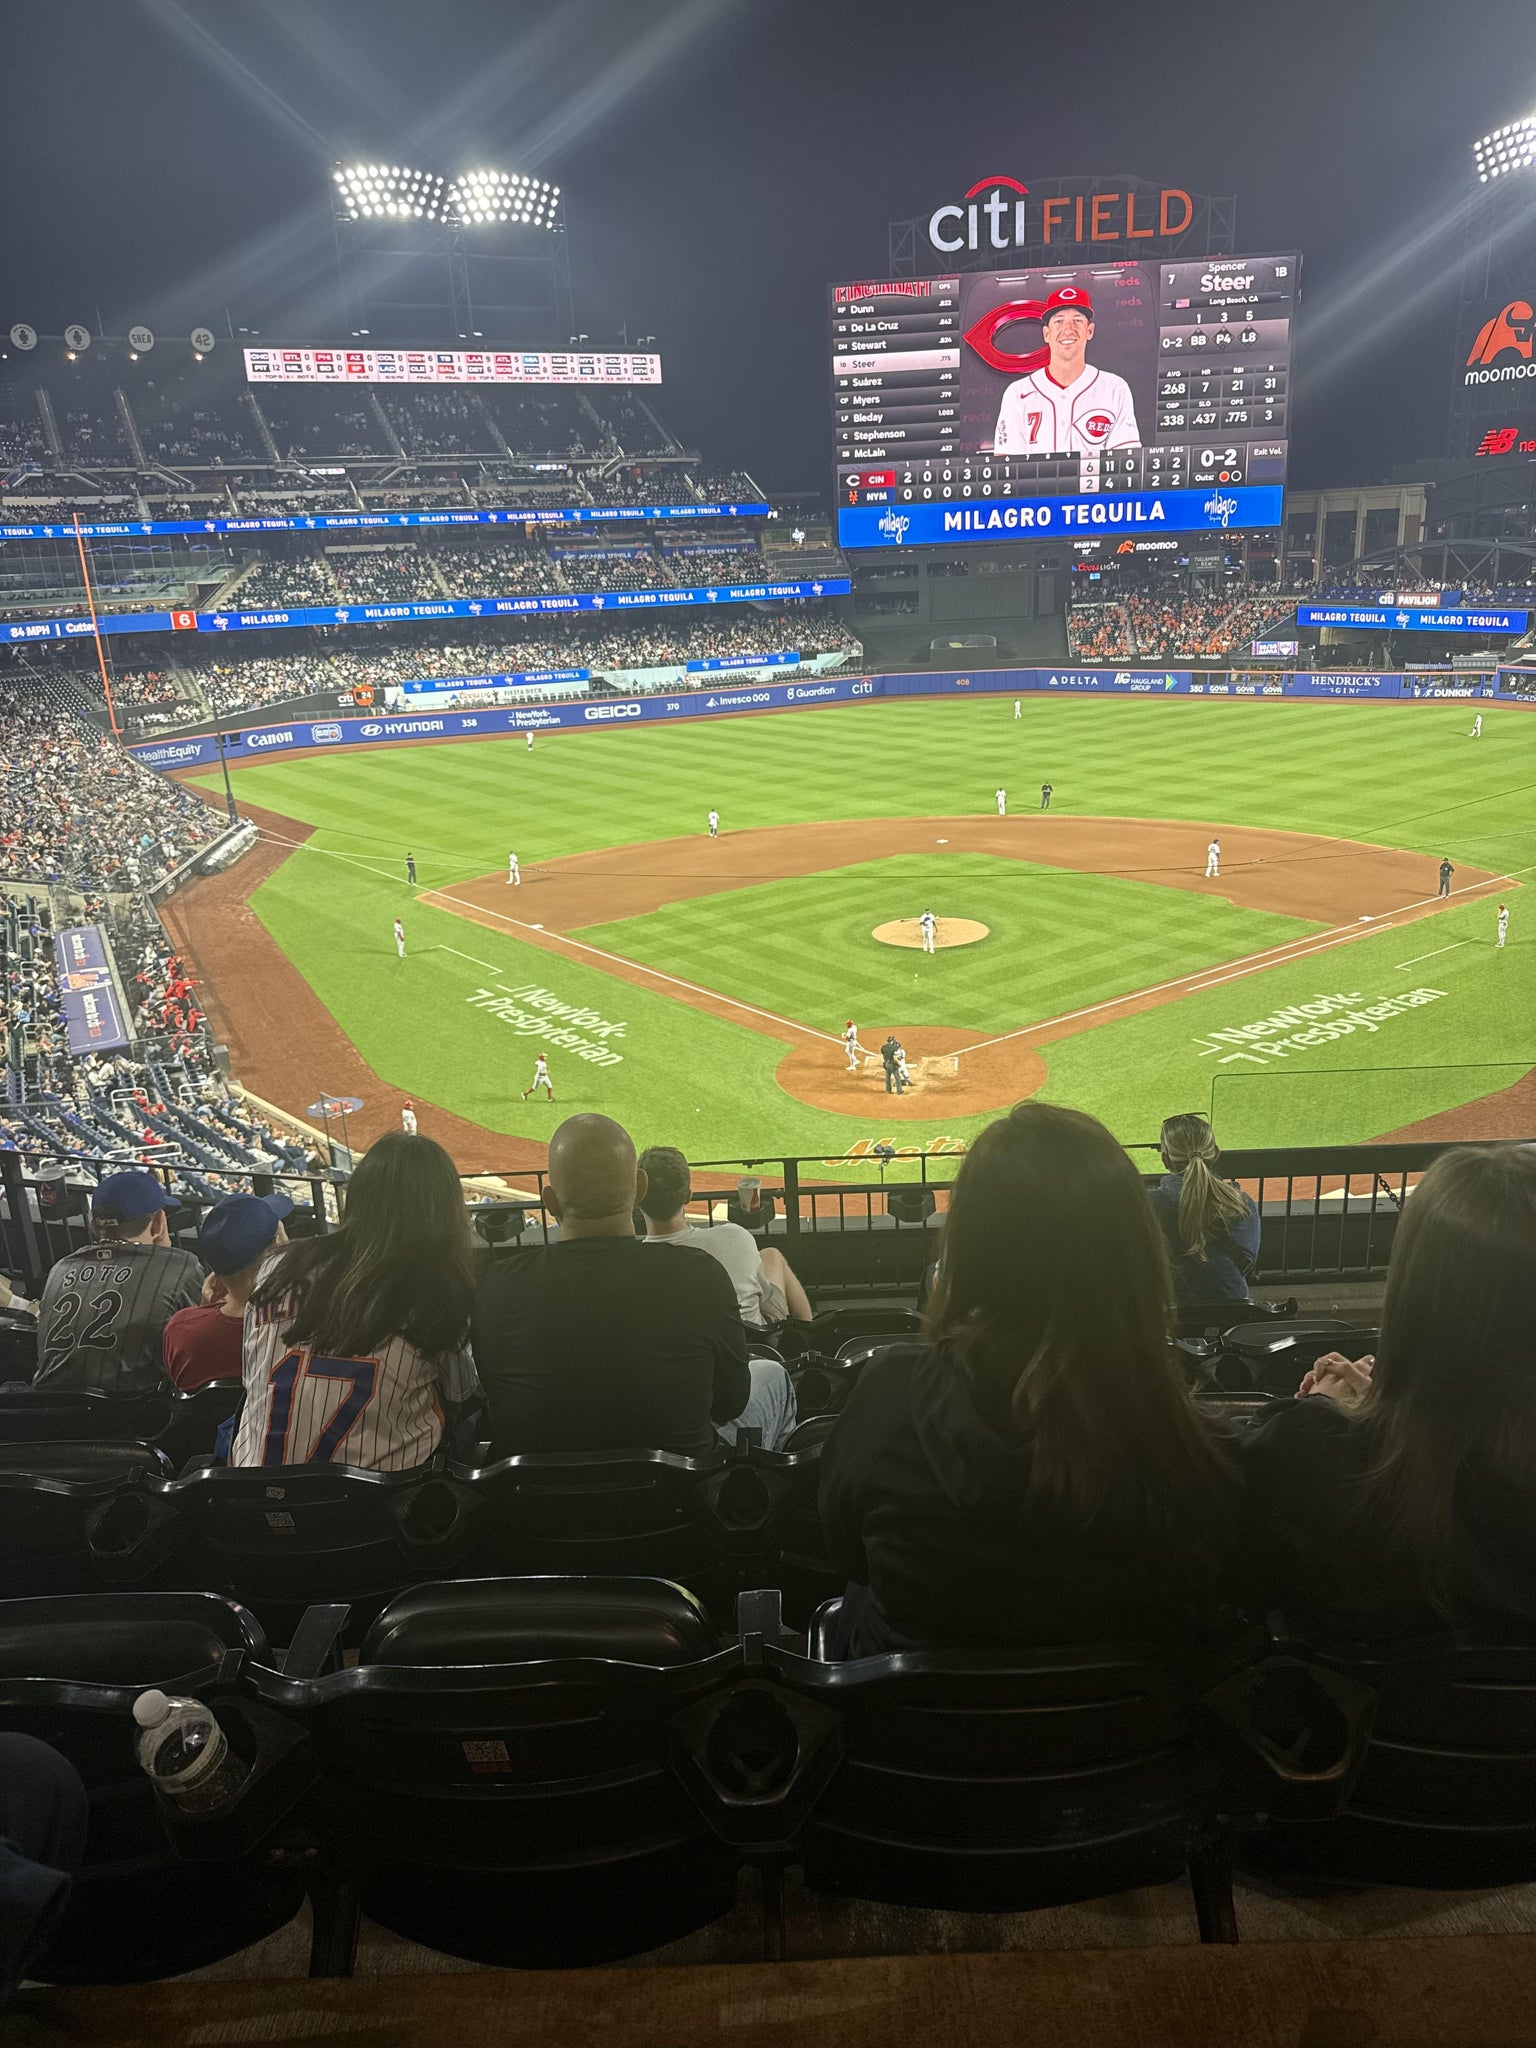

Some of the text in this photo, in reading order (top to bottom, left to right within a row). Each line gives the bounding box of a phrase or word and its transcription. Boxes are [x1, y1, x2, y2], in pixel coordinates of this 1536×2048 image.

[929, 187, 1193, 252] citi FIELD
[1209, 262, 1246, 273] Spencer
[1168, 266, 1287, 293] 7 Steer 1B
[835, 281, 931, 302] CINCINNATI
[1209, 295, 1258, 306] Long Beach, CA
[850, 304, 874, 315] Dunn
[1196, 311, 1253, 323] 1 3 5
[851, 321, 899, 332] De La Cruz
[132, 334, 152, 344] SHEA
[195, 334, 211, 346] 42
[1162, 331, 1256, 348] 0-2 BB P4 L8
[851, 340, 887, 351] Stewart
[272, 364, 280, 372] 12
[852, 359, 876, 369] Steer
[1201, 368, 1211, 376] HR
[1233, 366, 1244, 374] RBI
[1464, 363, 1536, 386] moomoo
[852, 376, 882, 388] Suárez
[1161, 377, 1276, 395] .268 7 21 31
[853, 395, 880, 407] Myers
[1198, 400, 1211, 408] SLG
[1230, 398, 1244, 406] OPS
[853, 412, 883, 424] Bleday
[1160, 410, 1272, 426] .338 .437 .775 3
[854, 428, 905, 443] Stephenson
[854, 448, 885, 459] McLain
[1253, 447, 1283, 456] Exit Vel.
[1200, 449, 1237, 467] 0-2
[868, 458, 1181, 484] CIN 2 0 0 3 0 1 6 11 0 3 2
[1195, 473, 1215, 482] Outs:
[866, 475, 1180, 501] NYM 0 0 0 0 0 2 2 4 1 2 2
[1204, 488, 1238, 528] milagro
[326, 517, 389, 525] MILAGRO TEQUILA
[944, 501, 1165, 531] MILAGRO TEQUILA
[878, 506, 911, 544] milagro
[1136, 541, 1178, 551] moomoo
[1077, 562, 1100, 572] Coors
[730, 586, 800, 598] MILAGRO TEQUILA
[497, 598, 578, 611] MILAGRO TEQUILA
[618, 592, 693, 605] MILAGRO TEQUILA
[1379, 592, 1438, 605] citi PAVILION
[365, 605, 454, 618] MILAGRO TEQUILA
[1310, 612, 1386, 623] MILAGRO TEQUILA
[179, 613, 190, 626] 6
[241, 613, 289, 625] MILAGRO
[1420, 615, 1509, 627] MILAGRO TEQUILA
[10, 627, 24, 638] 84
[26, 624, 50, 636] MPH
[1061, 676, 1098, 685] DELTA
[1311, 676, 1381, 687] HENDRICK'S
[796, 686, 836, 698] Guardian
[852, 680, 873, 694] citi
[1189, 685, 1203, 693] 380
[1235, 685, 1255, 693] GOYA
[1434, 688, 1474, 698] DUNKIN'
[1481, 689, 1493, 697] 370
[361, 691, 372, 699] 24
[720, 693, 770, 706] Invesco QQQ
[1516, 694, 1536, 702] CAD
[584, 703, 641, 719] GEICO
[666, 702, 680, 711] 370
[516, 709, 550, 719] NewYork-
[385, 720, 444, 733] HYUNDAI
[461, 718, 478, 728] 358
[516, 716, 561, 728] Presbyterian
[247, 731, 293, 748] Canon
[138, 744, 202, 762] HealthEquity
[513, 988, 628, 1038] NewYork-
[1207, 992, 1365, 1044] NewYork-
[1249, 987, 1449, 1057] Presbyterian
[475, 997, 624, 1067] Presbyterian
[63, 1265, 133, 1289] SOTO
[44, 1290, 123, 1353] 22
[264, 1350, 380, 1466] 17
